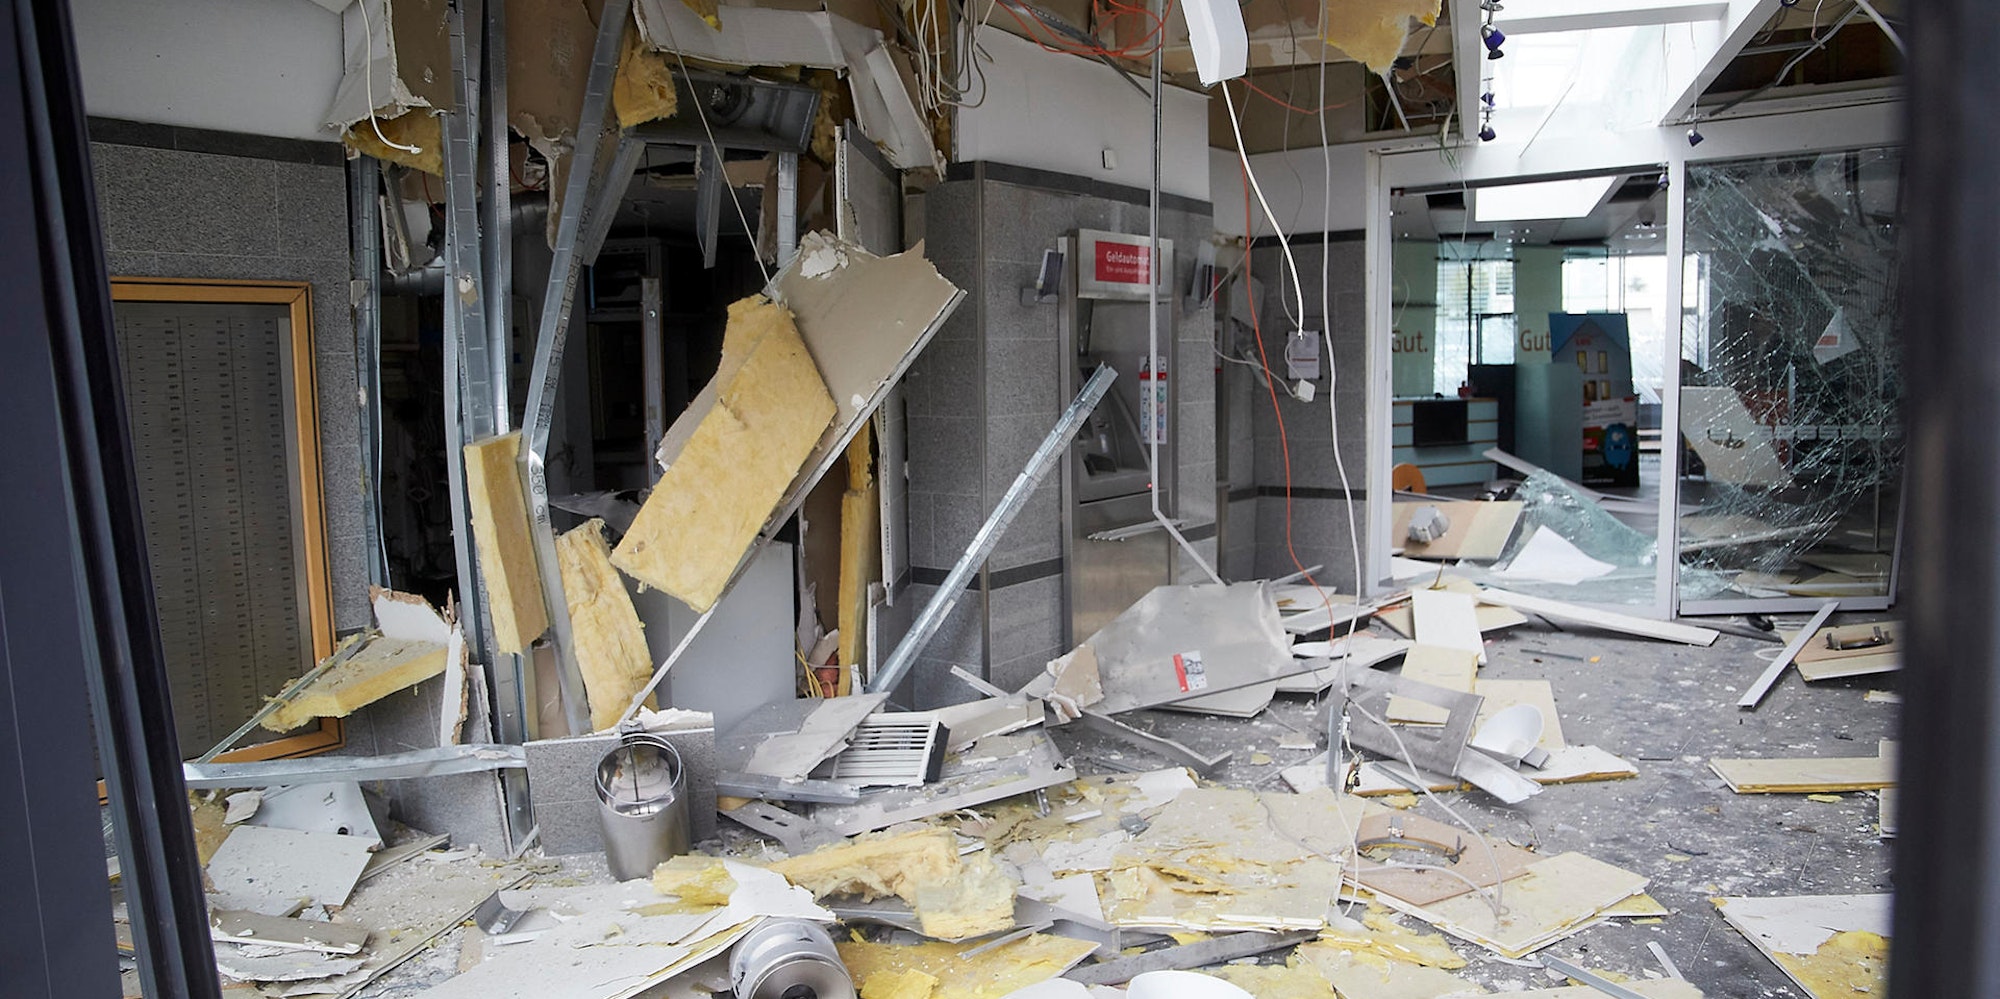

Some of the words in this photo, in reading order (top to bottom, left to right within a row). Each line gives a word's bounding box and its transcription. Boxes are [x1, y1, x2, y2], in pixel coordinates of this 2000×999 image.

[560, 254, 582, 313] PROFIL
[550, 326, 568, 366] 5215
[1392, 330, 1428, 352] Gut.
[1520, 329, 1551, 352] Gut
[531, 465, 546, 494] 350
[536, 504, 546, 525] cm
